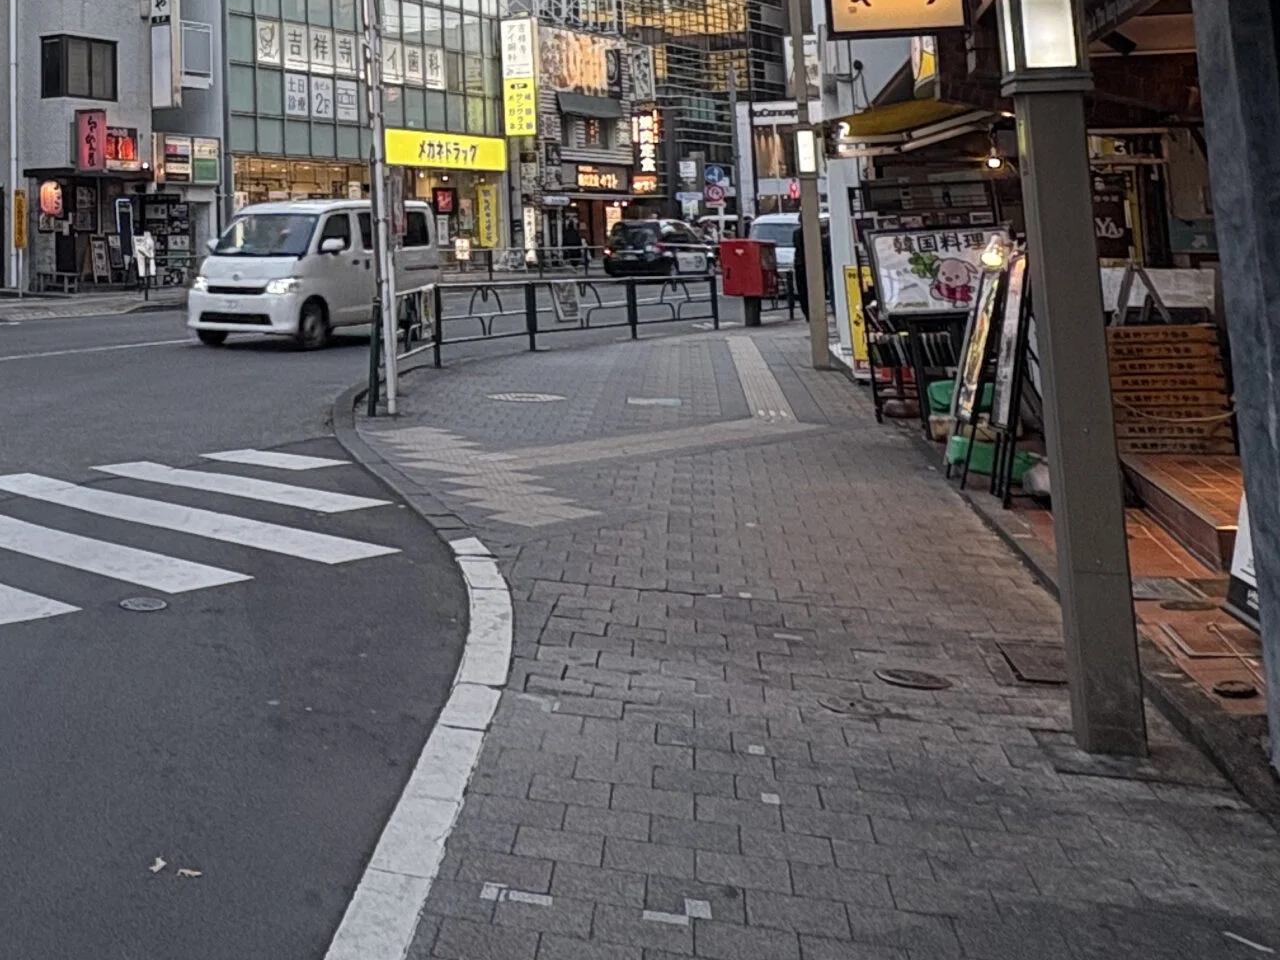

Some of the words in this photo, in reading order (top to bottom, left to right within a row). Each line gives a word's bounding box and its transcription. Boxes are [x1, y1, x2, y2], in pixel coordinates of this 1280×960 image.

[315, 92, 332, 115] 2F
[893, 232, 986, 254] 韓国料理
